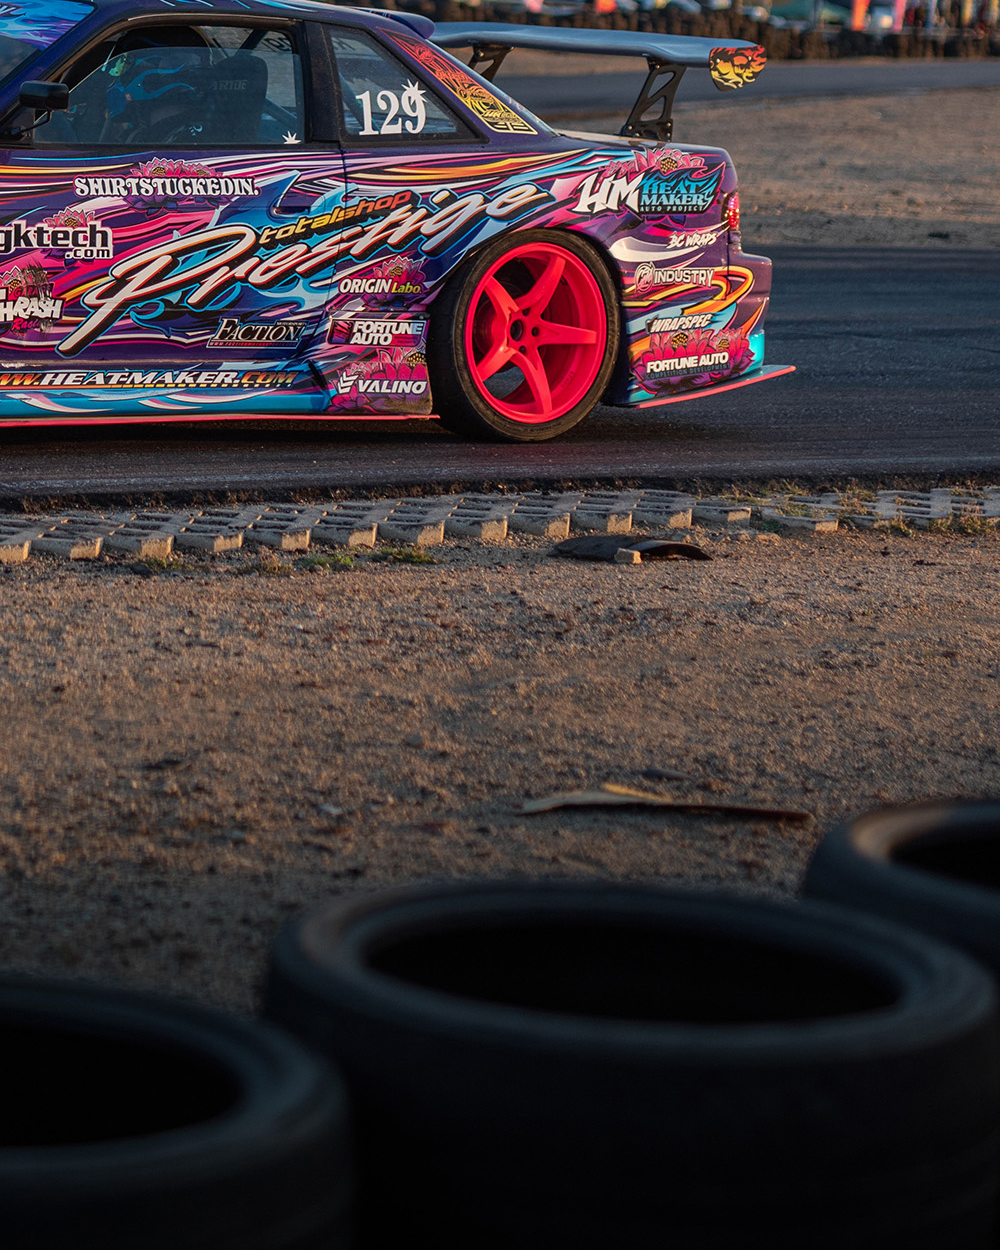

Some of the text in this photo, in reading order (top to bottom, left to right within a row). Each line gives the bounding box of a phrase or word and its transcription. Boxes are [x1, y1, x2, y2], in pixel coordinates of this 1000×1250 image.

[355, 85, 427, 136] 129
[572, 171, 647, 215] HM
[640, 173, 703, 195] HEAT
[259, 191, 412, 244] totalshop
[639, 205, 705, 213] AUTO PROJECT
[65, 248, 112, 259] .com
[56, 183, 550, 352] Prestige
[339, 278, 392, 294] ORIGIN
[653, 269, 715, 287] INDUSTRY
[352, 321, 424, 335] FORTUNE
[650, 314, 713, 333] WRAPSPEC
[350, 333, 393, 346] AUTO
[646, 351, 730, 374] FORTUNE AUTO
[358, 380, 428, 394] VALINO
